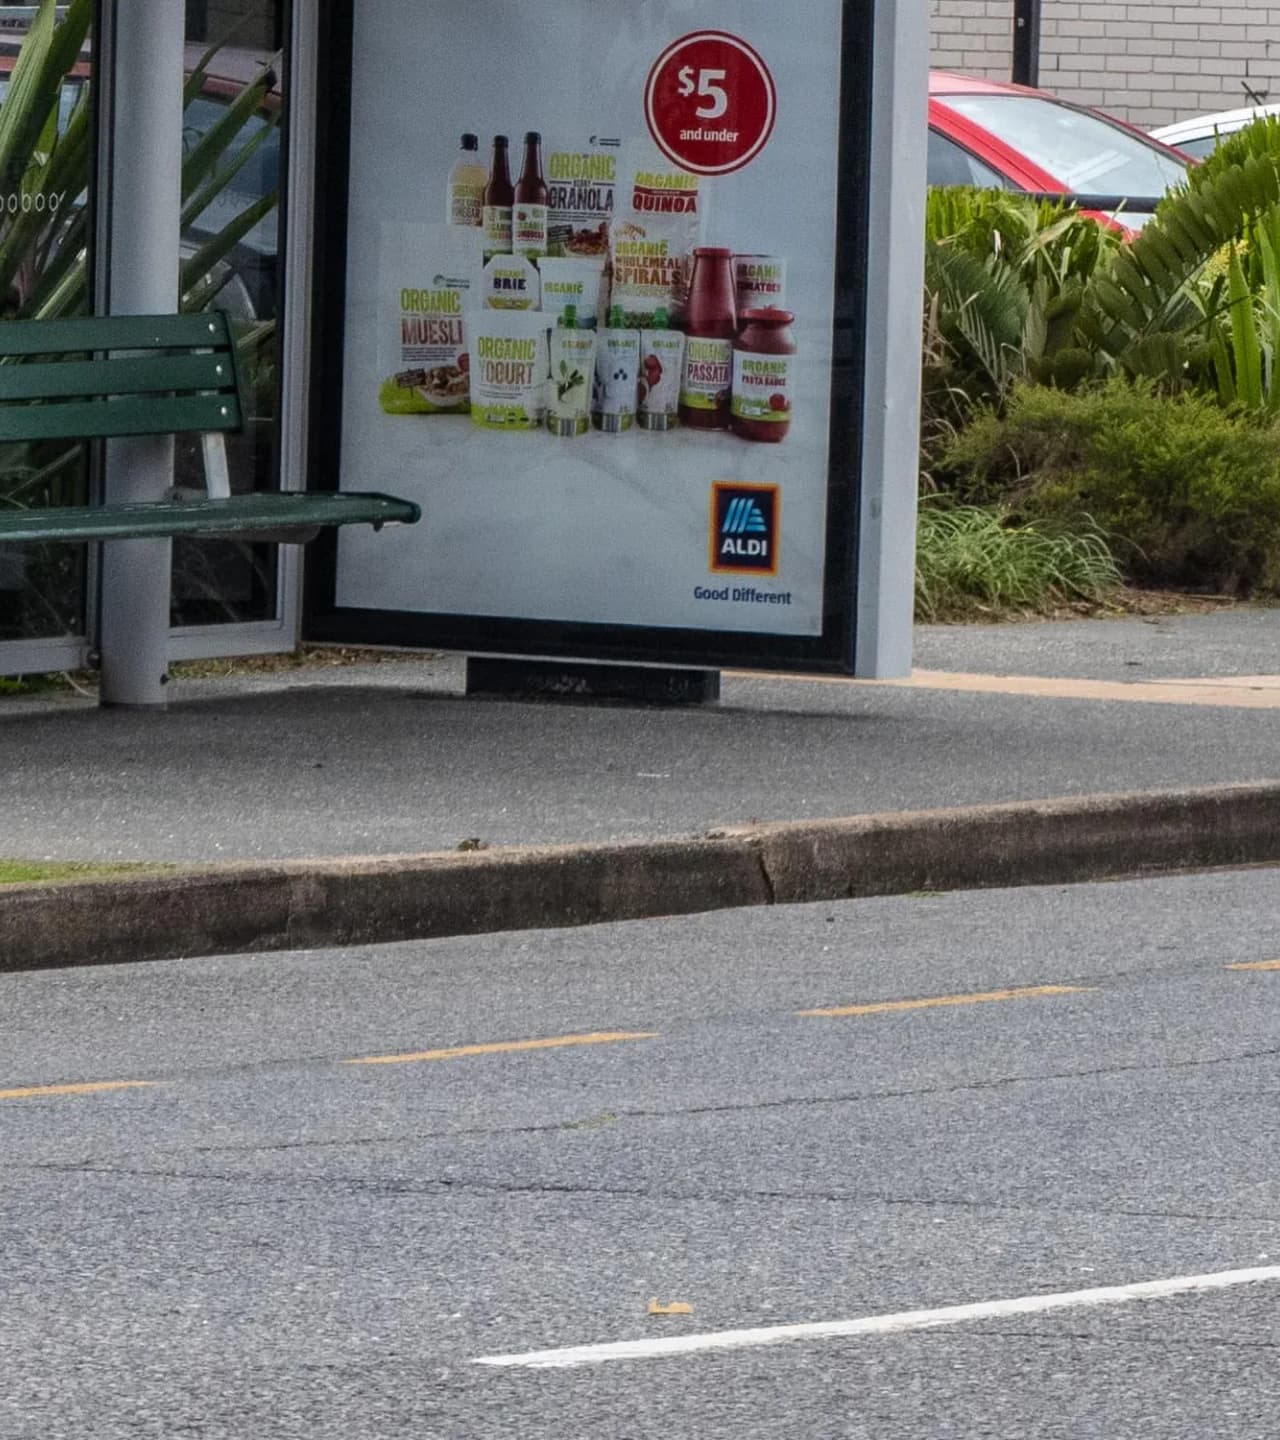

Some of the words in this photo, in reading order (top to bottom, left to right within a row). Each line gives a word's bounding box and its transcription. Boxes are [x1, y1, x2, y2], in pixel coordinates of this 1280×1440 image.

[677, 65, 729, 120] $5
[679, 127, 702, 142] and
[703, 128, 739, 144] under
[548, 152, 616, 181] ORGANIC
[548, 186, 615, 212] GRANOLA
[632, 191, 697, 213] QUINOA
[493, 277, 527, 291] BRIE
[615, 269, 682, 286] SPIRALS
[400, 288, 462, 313] ORGANIC
[401, 319, 463, 345] MUESLI
[477, 336, 536, 361] ORGANIC
[687, 364, 729, 385] PASSATA
[721, 538, 767, 556] ALDI
[694, 586, 729, 601] Good
[732, 588, 792, 605] Different
